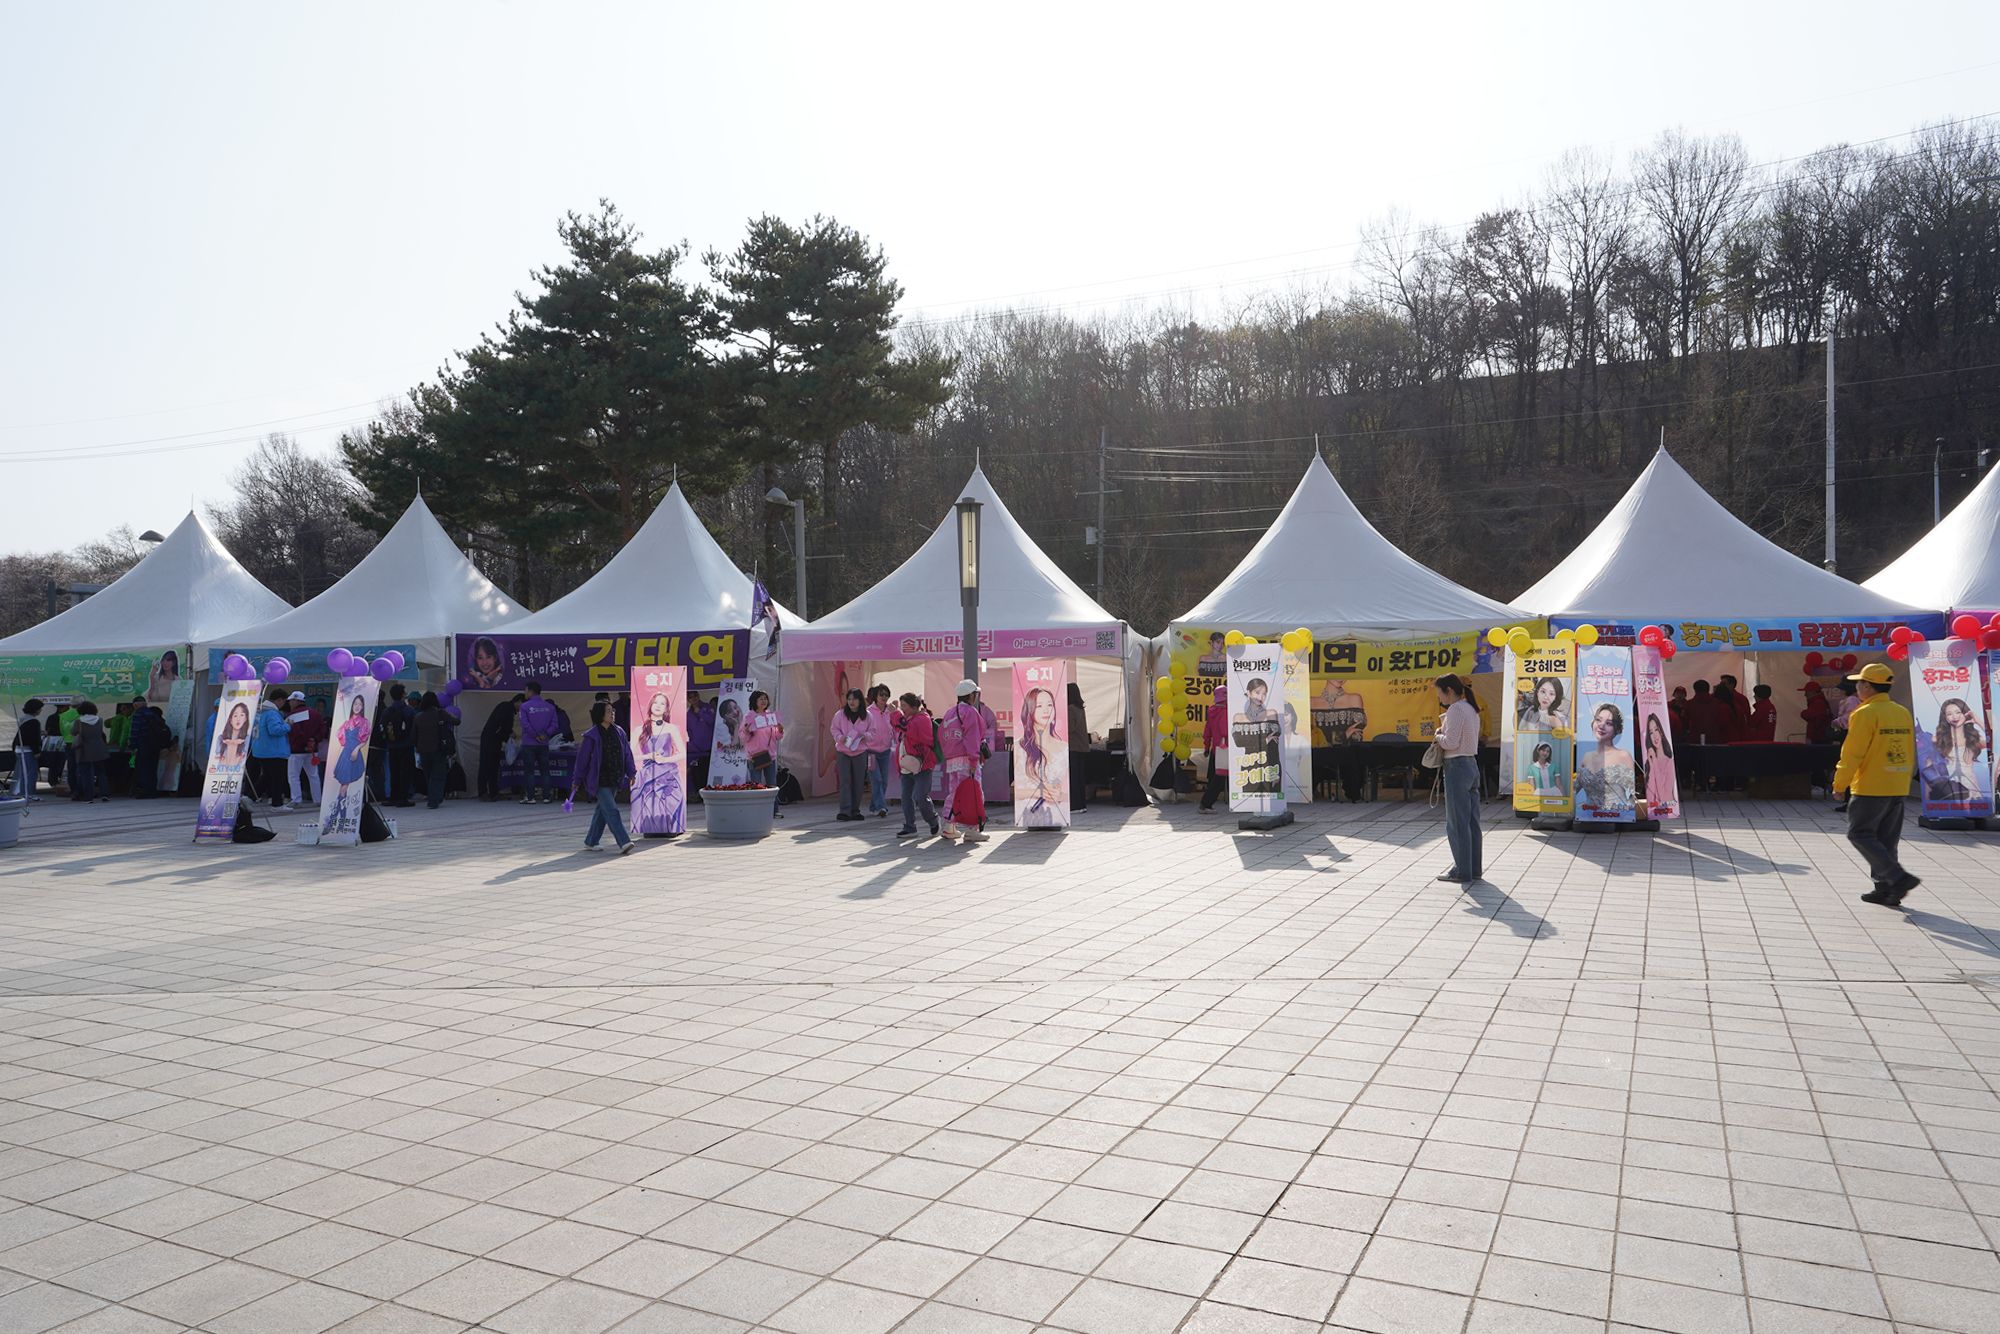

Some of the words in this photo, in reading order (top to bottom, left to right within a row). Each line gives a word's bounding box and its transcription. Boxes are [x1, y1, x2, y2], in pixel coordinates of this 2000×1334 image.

[1680, 622, 1752, 648] 홍지윤
[510, 651, 541, 665] 공주님이
[583, 634, 735, 687] 김태연
[1389, 648, 1461, 671] 왔다야
[1524, 659, 1566, 673] 강혜연
[515, 666, 536, 679] 내가
[539, 660, 574, 678] 미쳤다!
[1026, 666, 1053, 682] 솔지
[1922, 666, 1970, 685] 홍지윤
[81, 673, 133, 693] 구수경
[645, 672, 672, 687] 솔지
[725, 682, 755, 693] 김태연
[211, 781, 238, 794] 김태연
